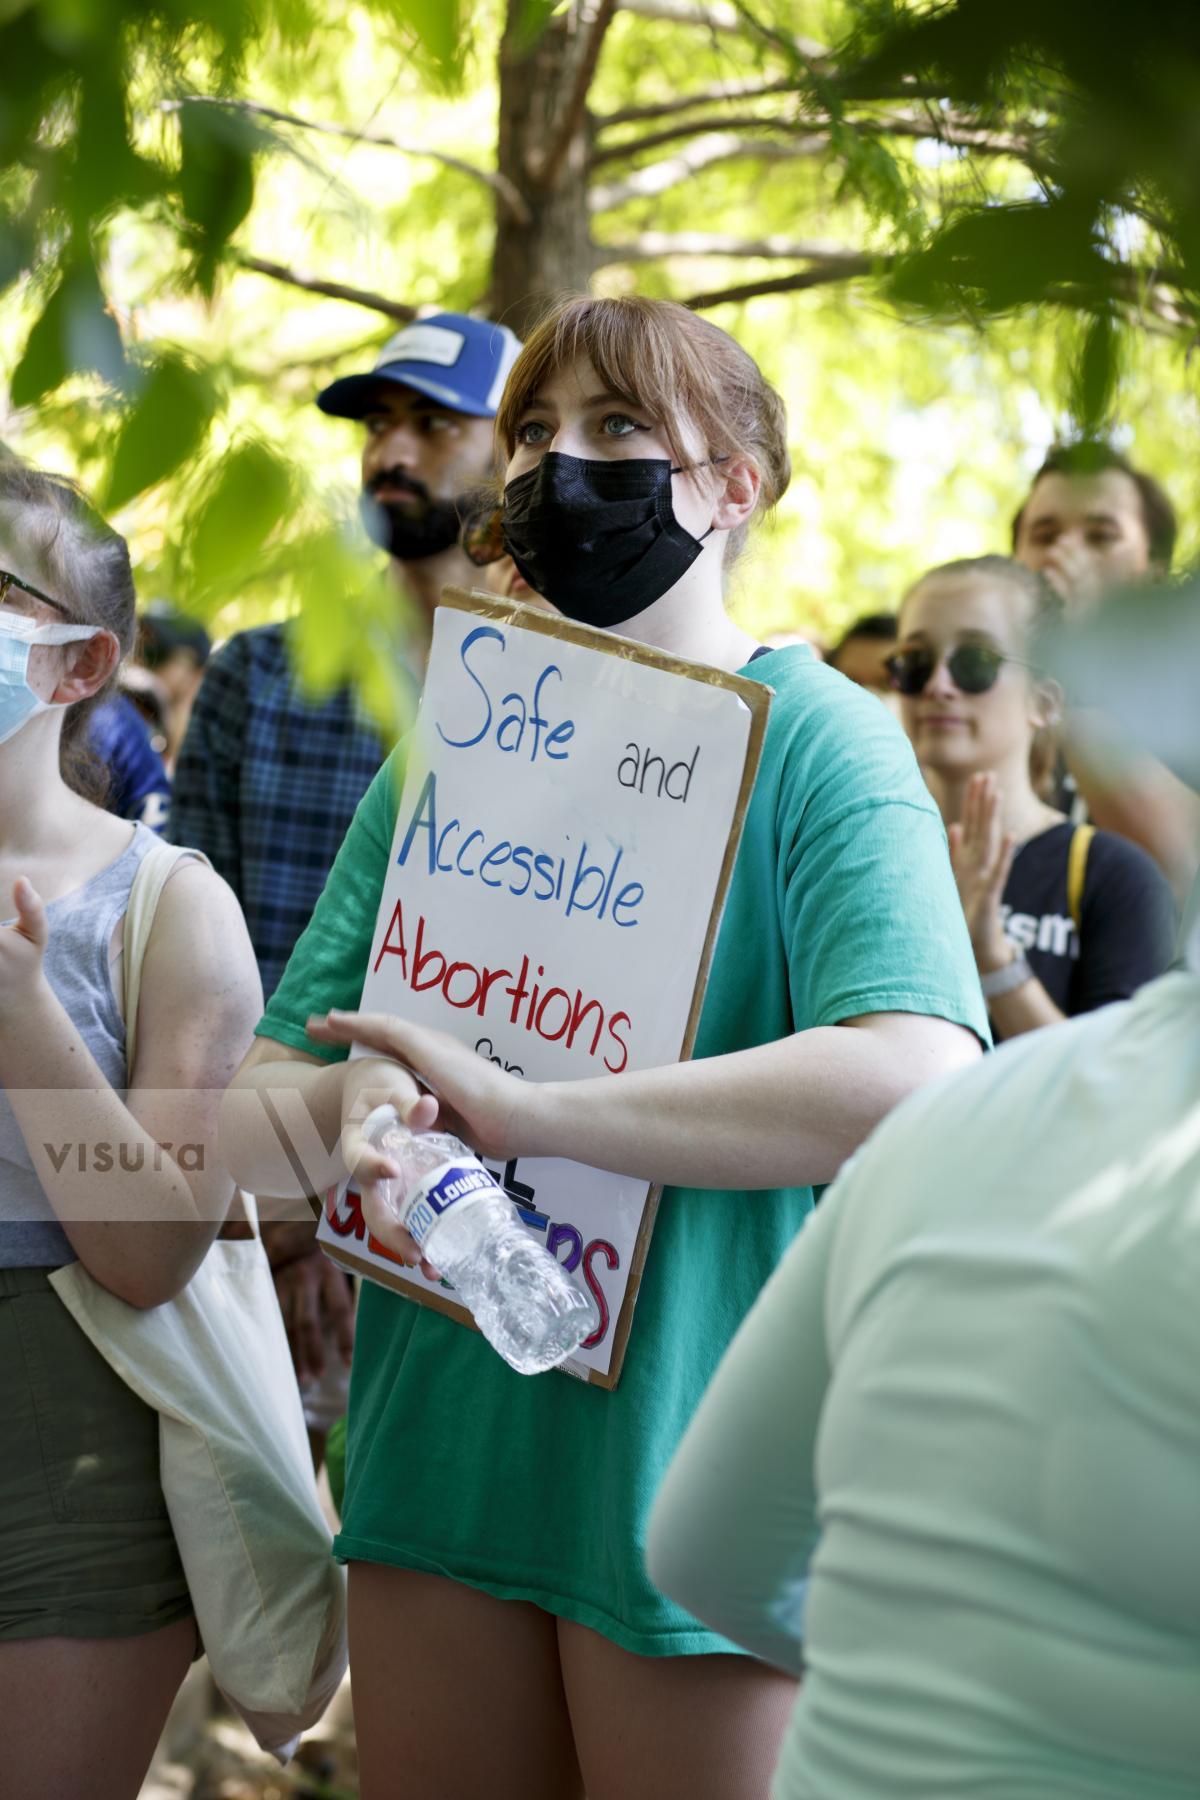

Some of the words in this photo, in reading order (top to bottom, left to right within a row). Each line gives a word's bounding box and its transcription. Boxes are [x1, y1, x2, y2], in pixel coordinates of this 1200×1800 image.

[435, 626, 575, 761] Safe
[617, 743, 700, 803] and
[397, 771, 645, 928] Accessible
[373, 898, 632, 1074] Abortions
